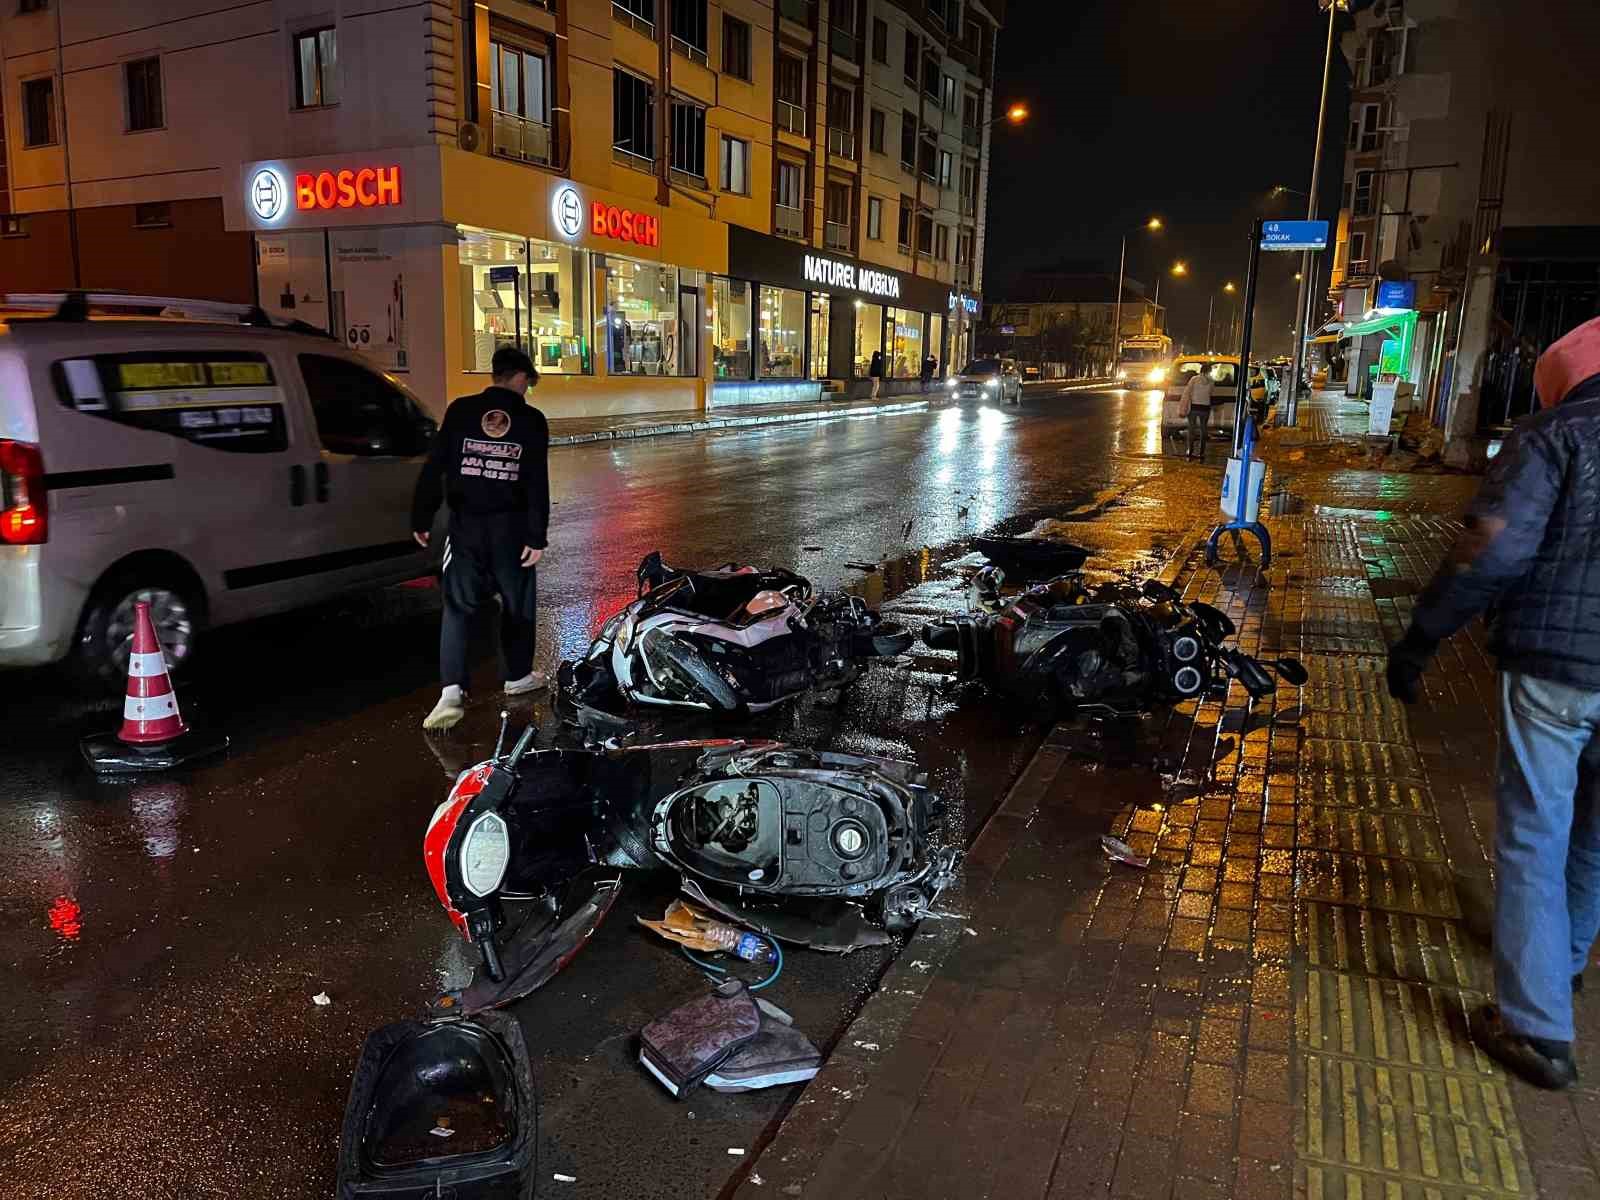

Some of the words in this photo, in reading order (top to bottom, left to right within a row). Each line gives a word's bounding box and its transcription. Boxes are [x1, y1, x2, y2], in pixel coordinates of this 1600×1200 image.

[295, 166, 401, 210] BOSCH
[592, 201, 658, 246] BOSCH
[804, 255, 856, 289] NATUREL
[859, 268, 900, 298] MOBİLYA
